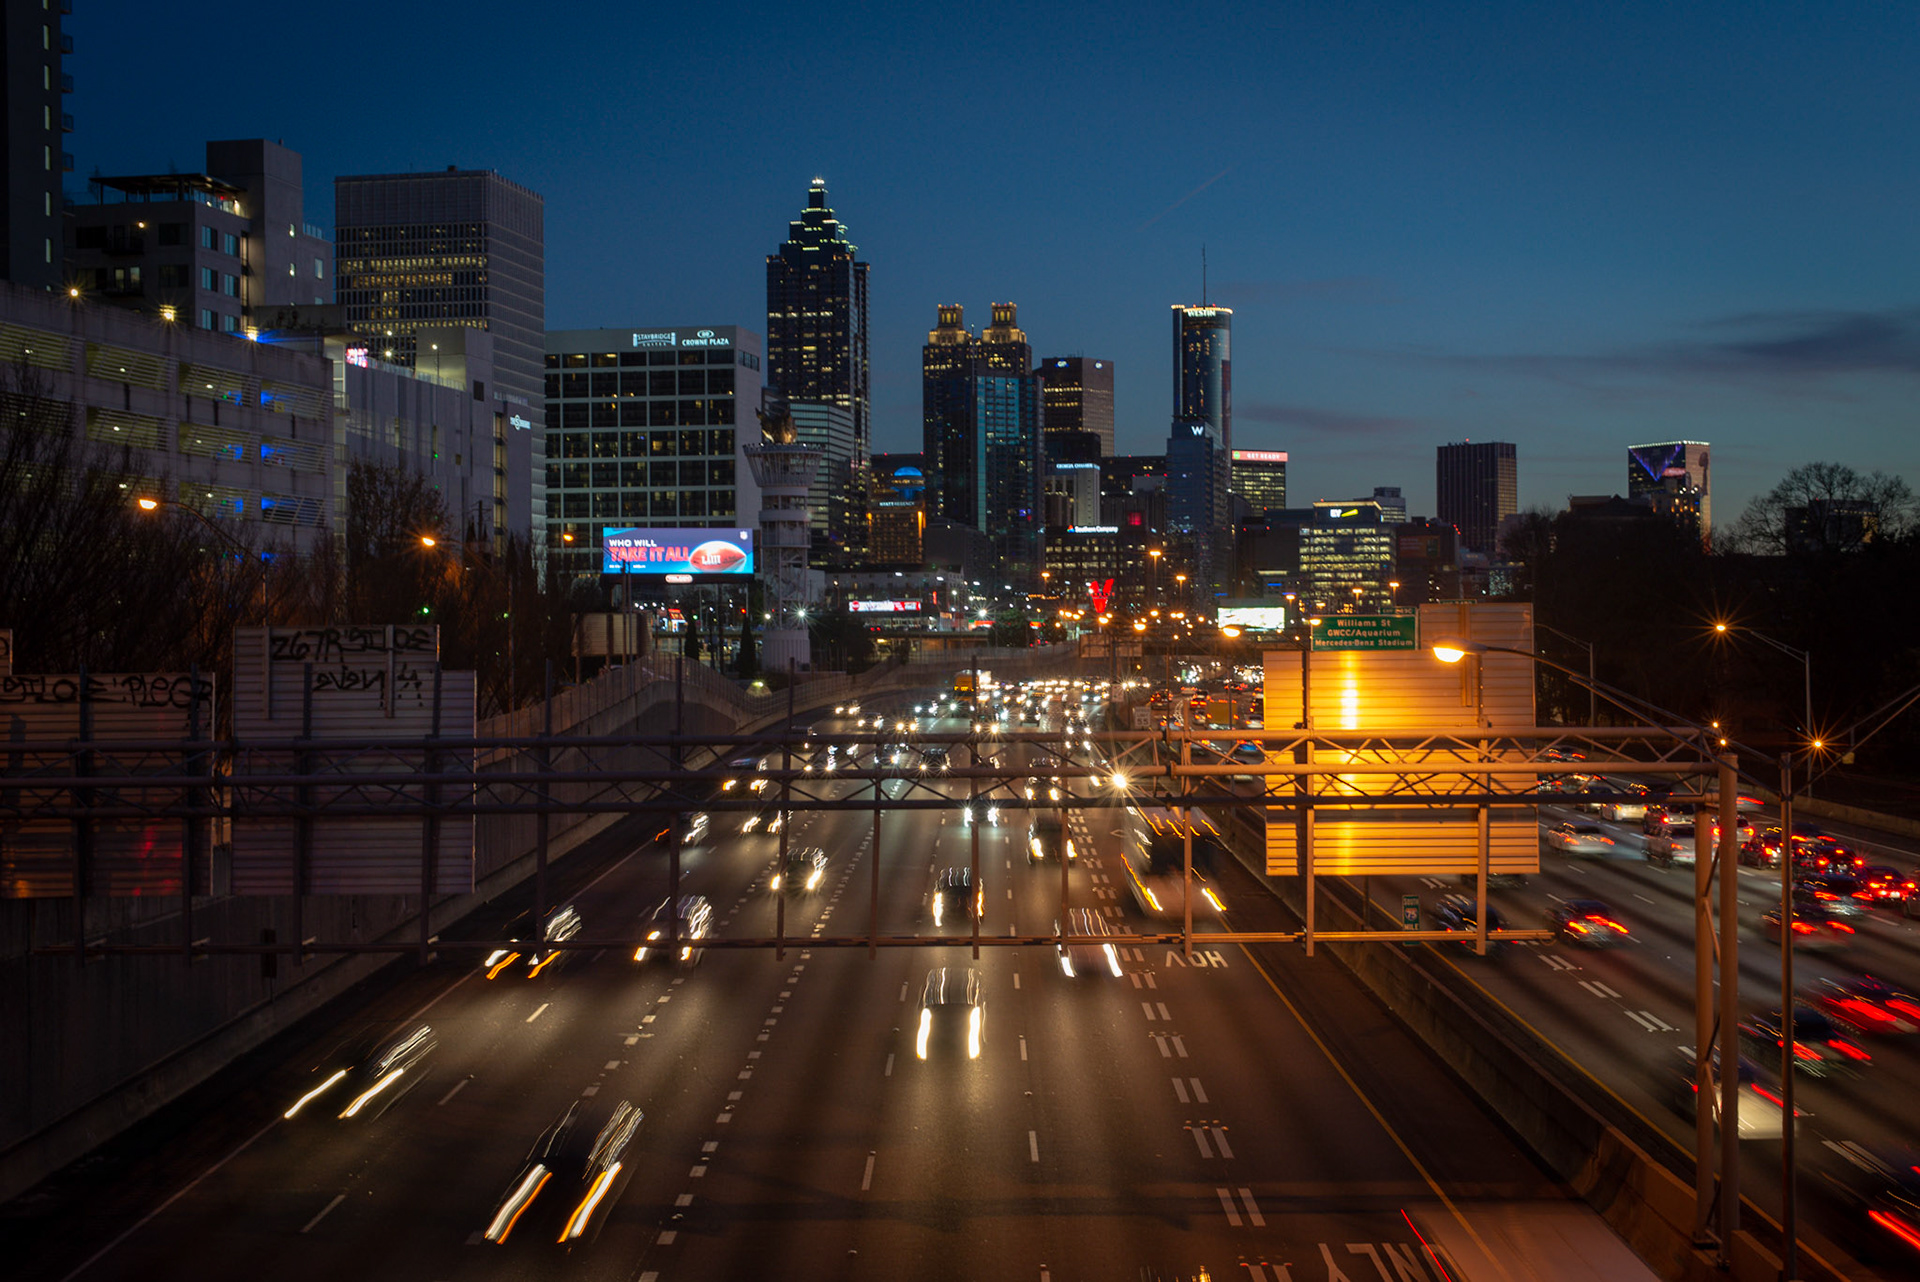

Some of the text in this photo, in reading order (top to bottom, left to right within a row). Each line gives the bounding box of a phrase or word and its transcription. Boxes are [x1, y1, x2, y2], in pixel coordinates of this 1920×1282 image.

[1187, 309, 1217, 318] WESTIN
[637, 333, 671, 341] STAYBRIDGE
[682, 338, 729, 347] CROWNE PLAZA
[1191, 425, 1204, 436] W
[609, 539, 657, 548] WHO WILL
[608, 547, 689, 562] TAKE IT ALL
[1337, 619, 1391, 627] Williams St
[1327, 629, 1401, 638] GWCC/Aquarium
[1165, 950, 1229, 968] HOV
